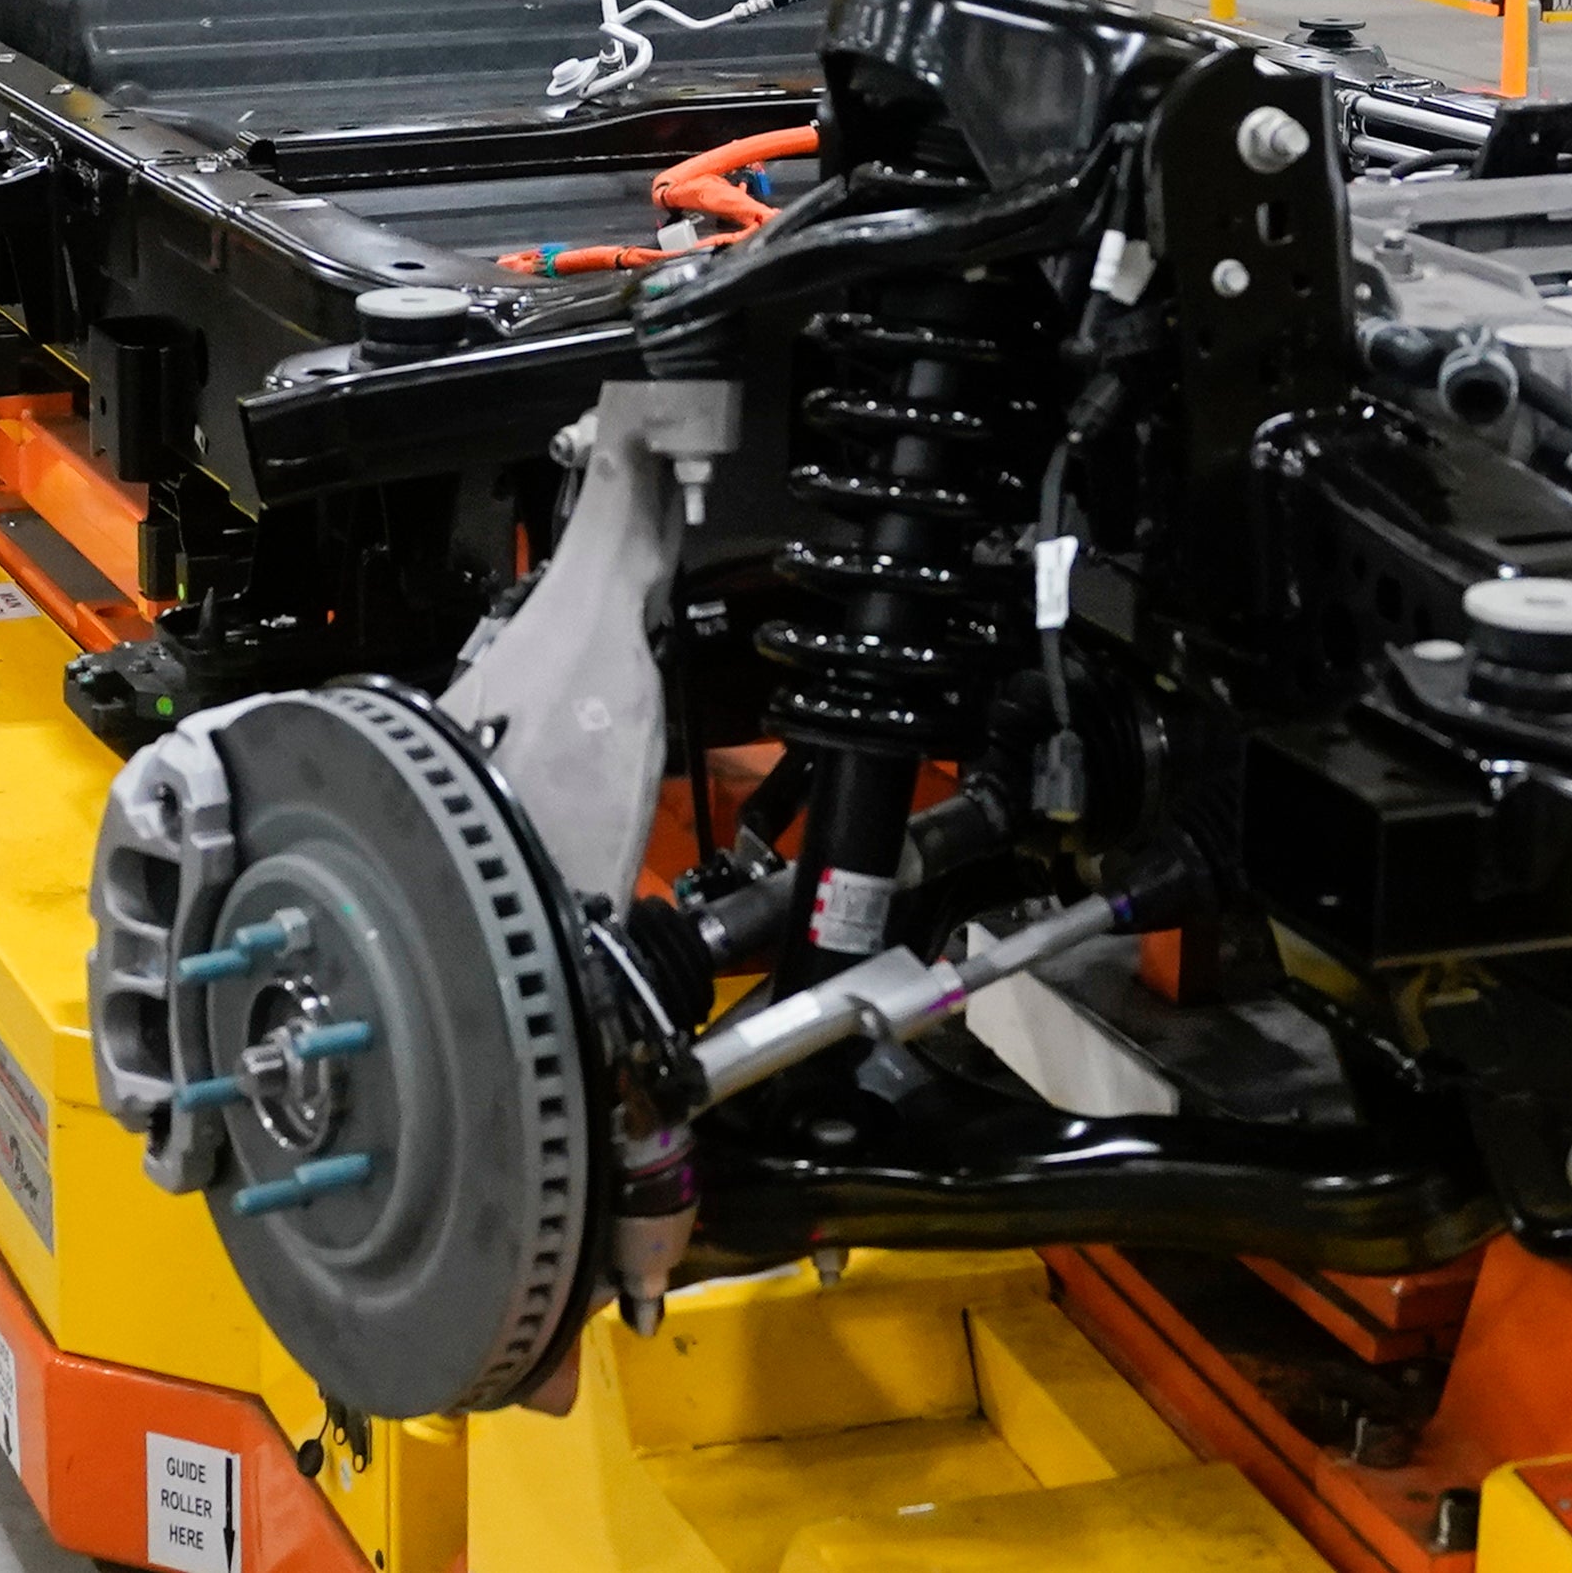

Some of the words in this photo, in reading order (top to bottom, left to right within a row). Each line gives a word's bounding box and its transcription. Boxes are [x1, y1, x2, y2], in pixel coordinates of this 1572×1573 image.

[166, 1457, 207, 1484] GUIDE
[161, 1488, 213, 1519] ROLLER
[169, 1524, 205, 1551] HERE
